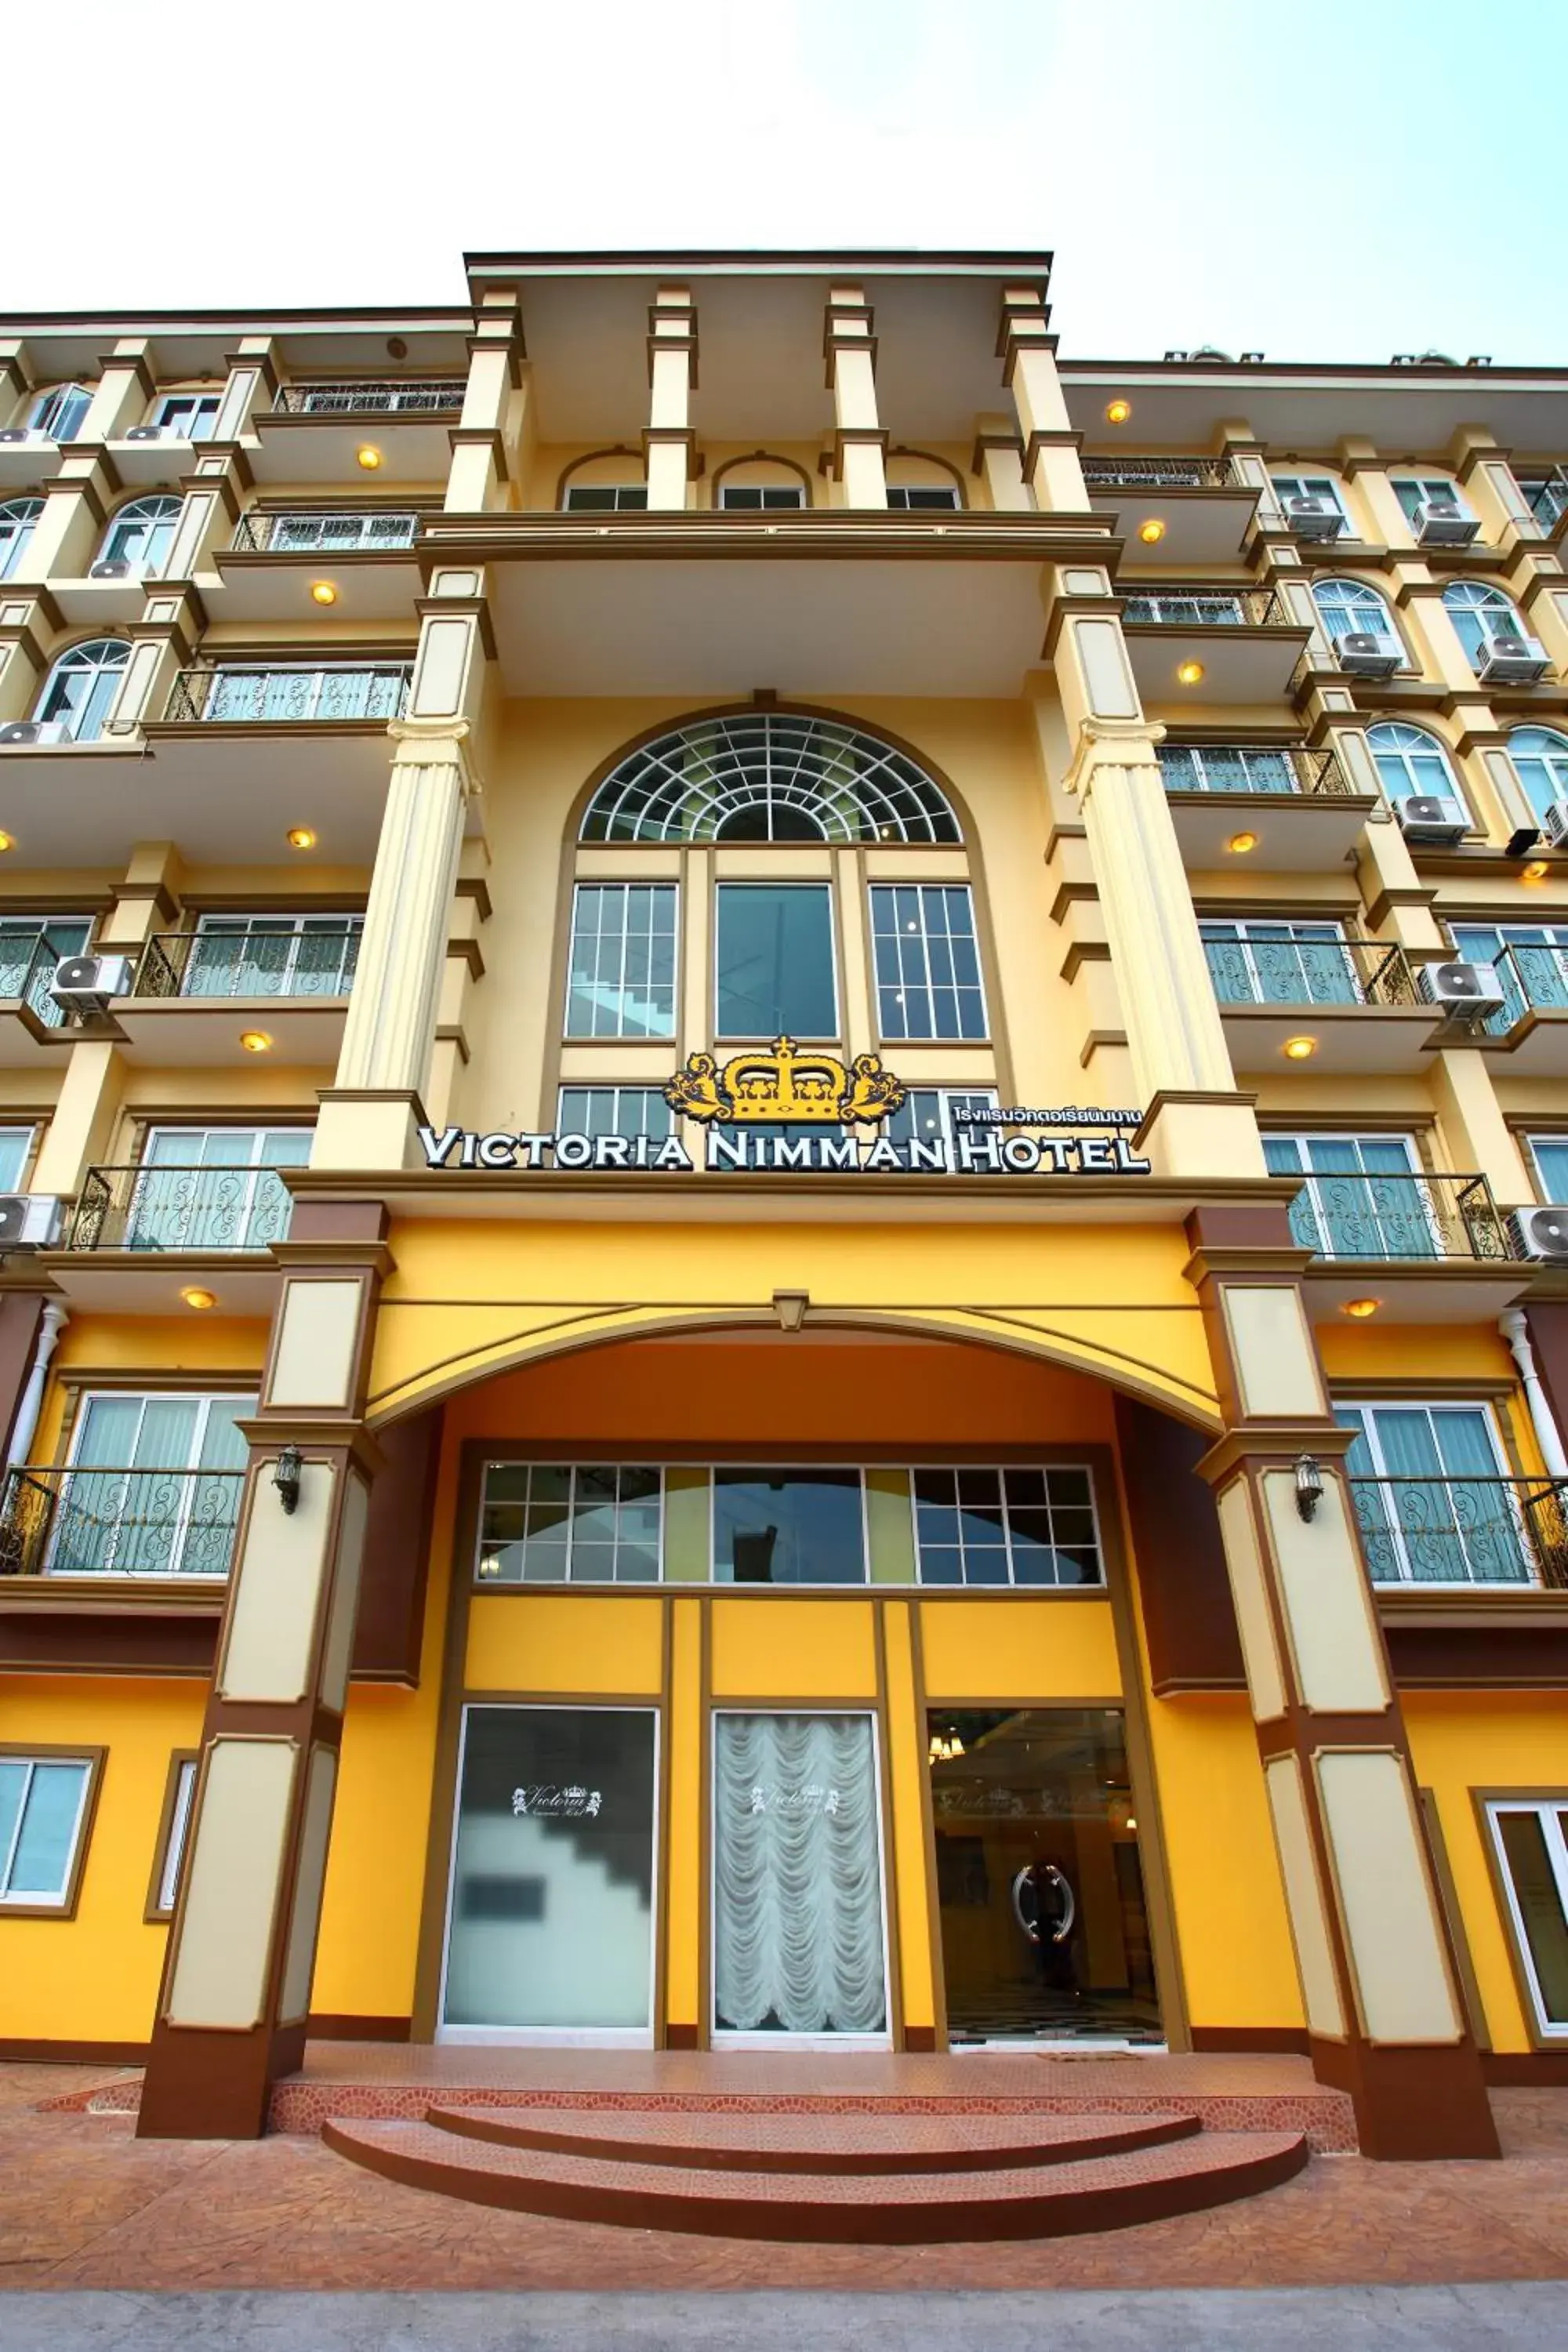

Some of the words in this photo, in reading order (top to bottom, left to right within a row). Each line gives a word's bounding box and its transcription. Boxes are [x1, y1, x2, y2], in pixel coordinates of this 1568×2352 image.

[953, 1106, 1142, 1126] โรงแรมวิกตอเรียนิมมาน
[418, 1127, 694, 1171] VICTORIA
[706, 1131, 947, 1171] NIMMAN
[957, 1132, 1151, 1174] HOTEL
